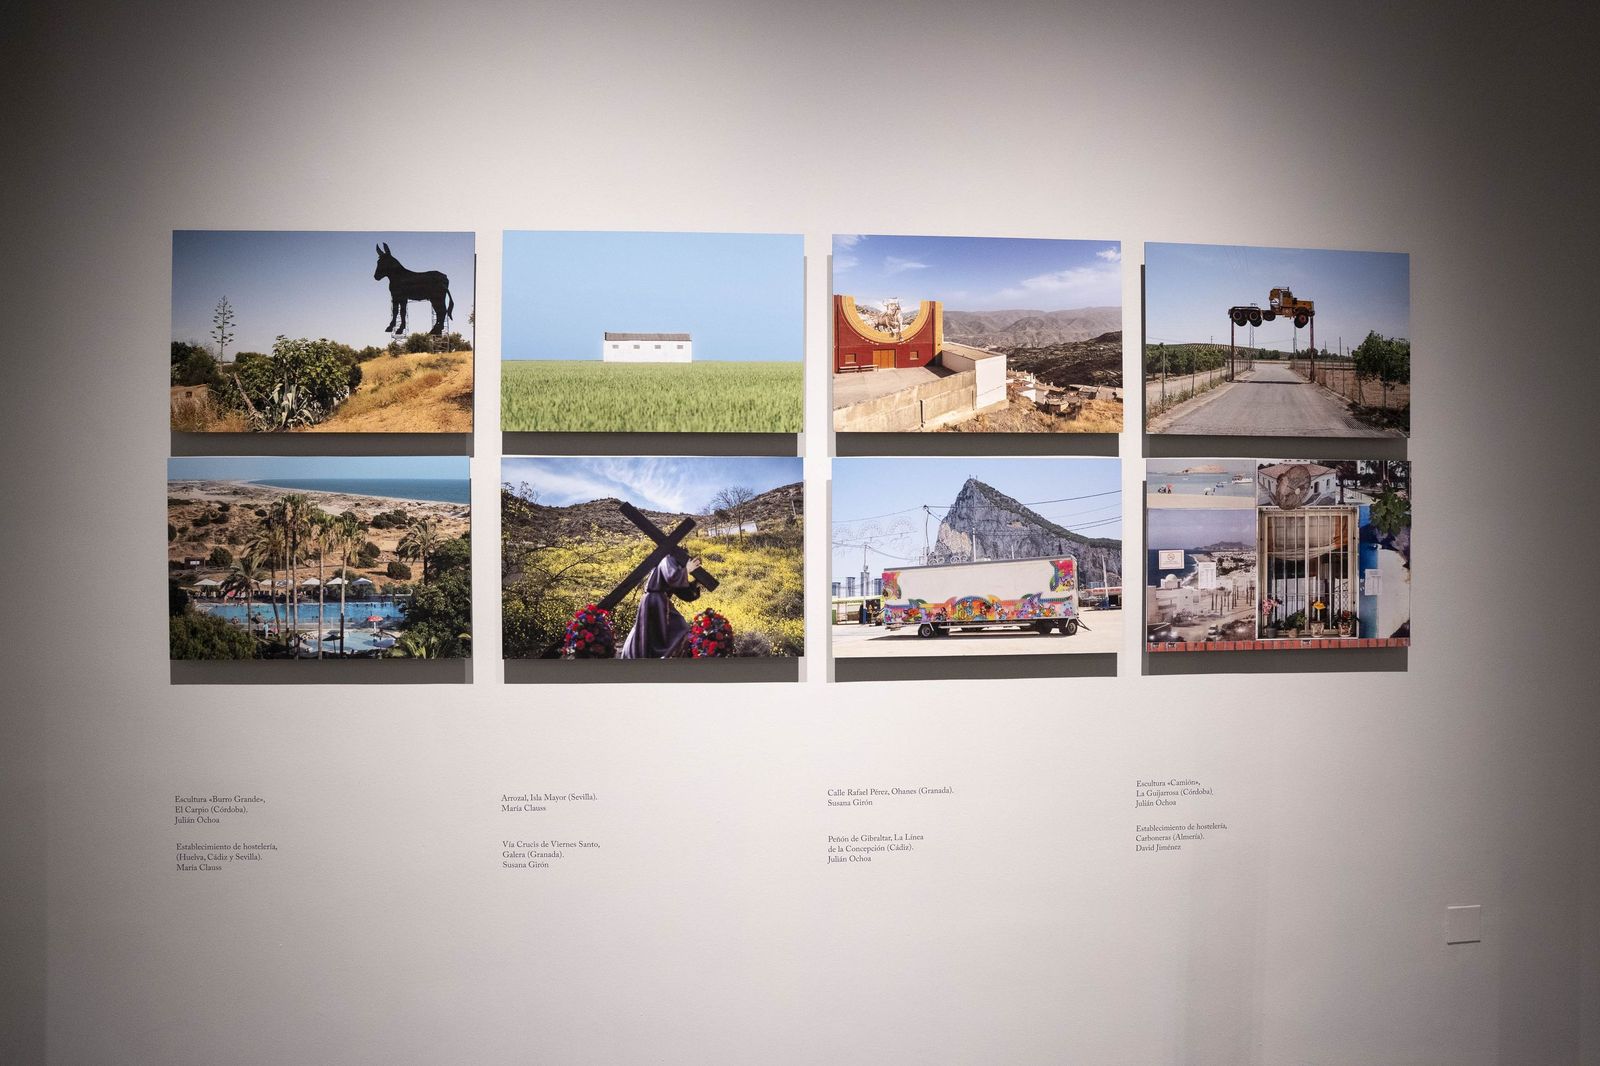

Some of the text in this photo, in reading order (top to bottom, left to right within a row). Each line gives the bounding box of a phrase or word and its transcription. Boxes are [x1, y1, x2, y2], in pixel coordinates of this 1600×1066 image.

[1136, 779, 1165, 787] Escultura
[870, 788, 890, 796] Pérez,
[891, 787, 917, 795] Ohanes
[918, 786, 954, 795] (Granada).
[1136, 789, 1144, 797] La
[1146, 790, 1179, 798] Guijarrosa
[175, 795, 265, 803] Escultura «Burro Grande»,
[501, 792, 597, 803] Arrozal, Isla Mayor (Sevilla).
[827, 798, 873, 806] Susana Girón
[1135, 800, 1154, 808] Julián
[185, 806, 209, 815] Carpio
[211, 806, 248, 814] (Córdoba).
[501, 804, 522, 812] María
[174, 816, 220, 825] Julián Ochoa
[861, 834, 892, 843] Gibraltar,
[1173, 833, 1204, 841] (Almería).
[177, 843, 277, 851] Establecimiento de hostelería,
[579, 840, 600, 848] Santo,
[1155, 844, 1181, 852] Jiménez
[846, 845, 885, 854] Concepción
[887, 843, 914, 852] (Cádiz).
[176, 853, 206, 862] (Huelva,
[207, 853, 228, 861] Cádiz
[235, 853, 263, 861] Sevilla).
[503, 850, 564, 859] Galera (Granada).
[827, 855, 871, 864] Julián Ochoa
[502, 861, 526, 869] Susana
